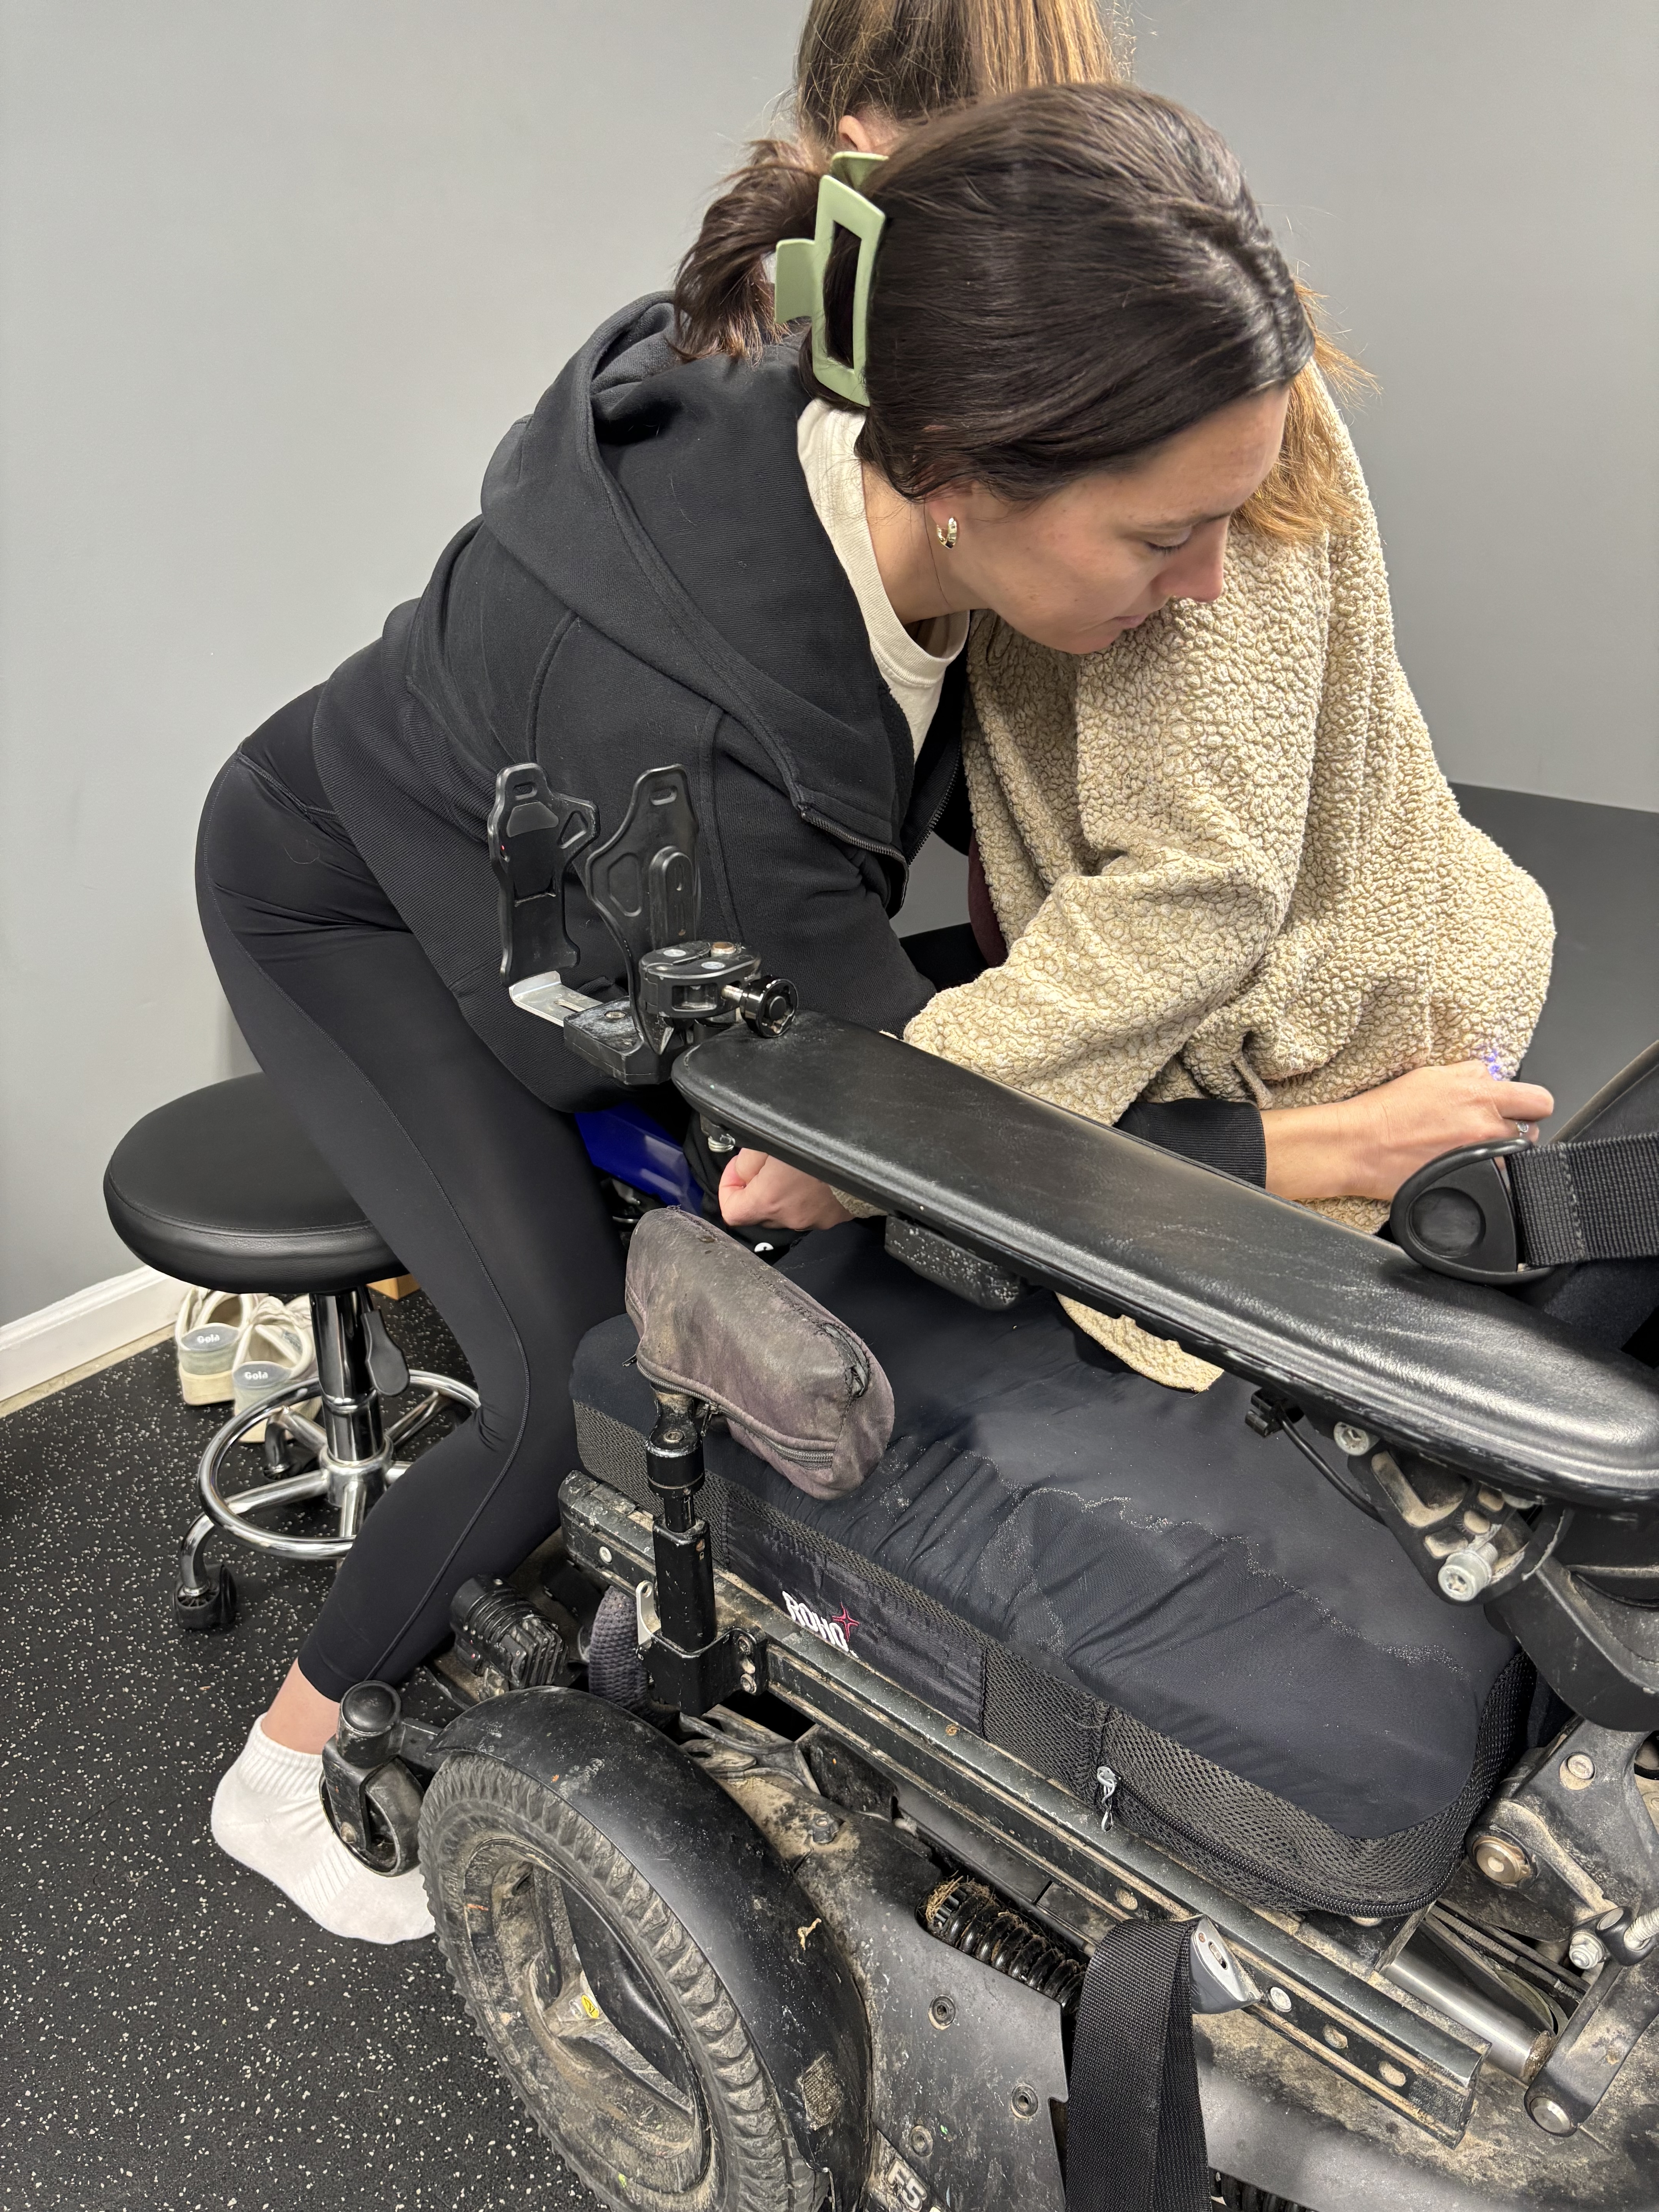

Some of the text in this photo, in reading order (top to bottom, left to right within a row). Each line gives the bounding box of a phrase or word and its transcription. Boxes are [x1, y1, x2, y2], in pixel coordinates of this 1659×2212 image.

[197, 1334, 220, 1344] Gola
[244, 1370, 268, 1380] Gola
[782, 1590, 849, 1652] ROHO
